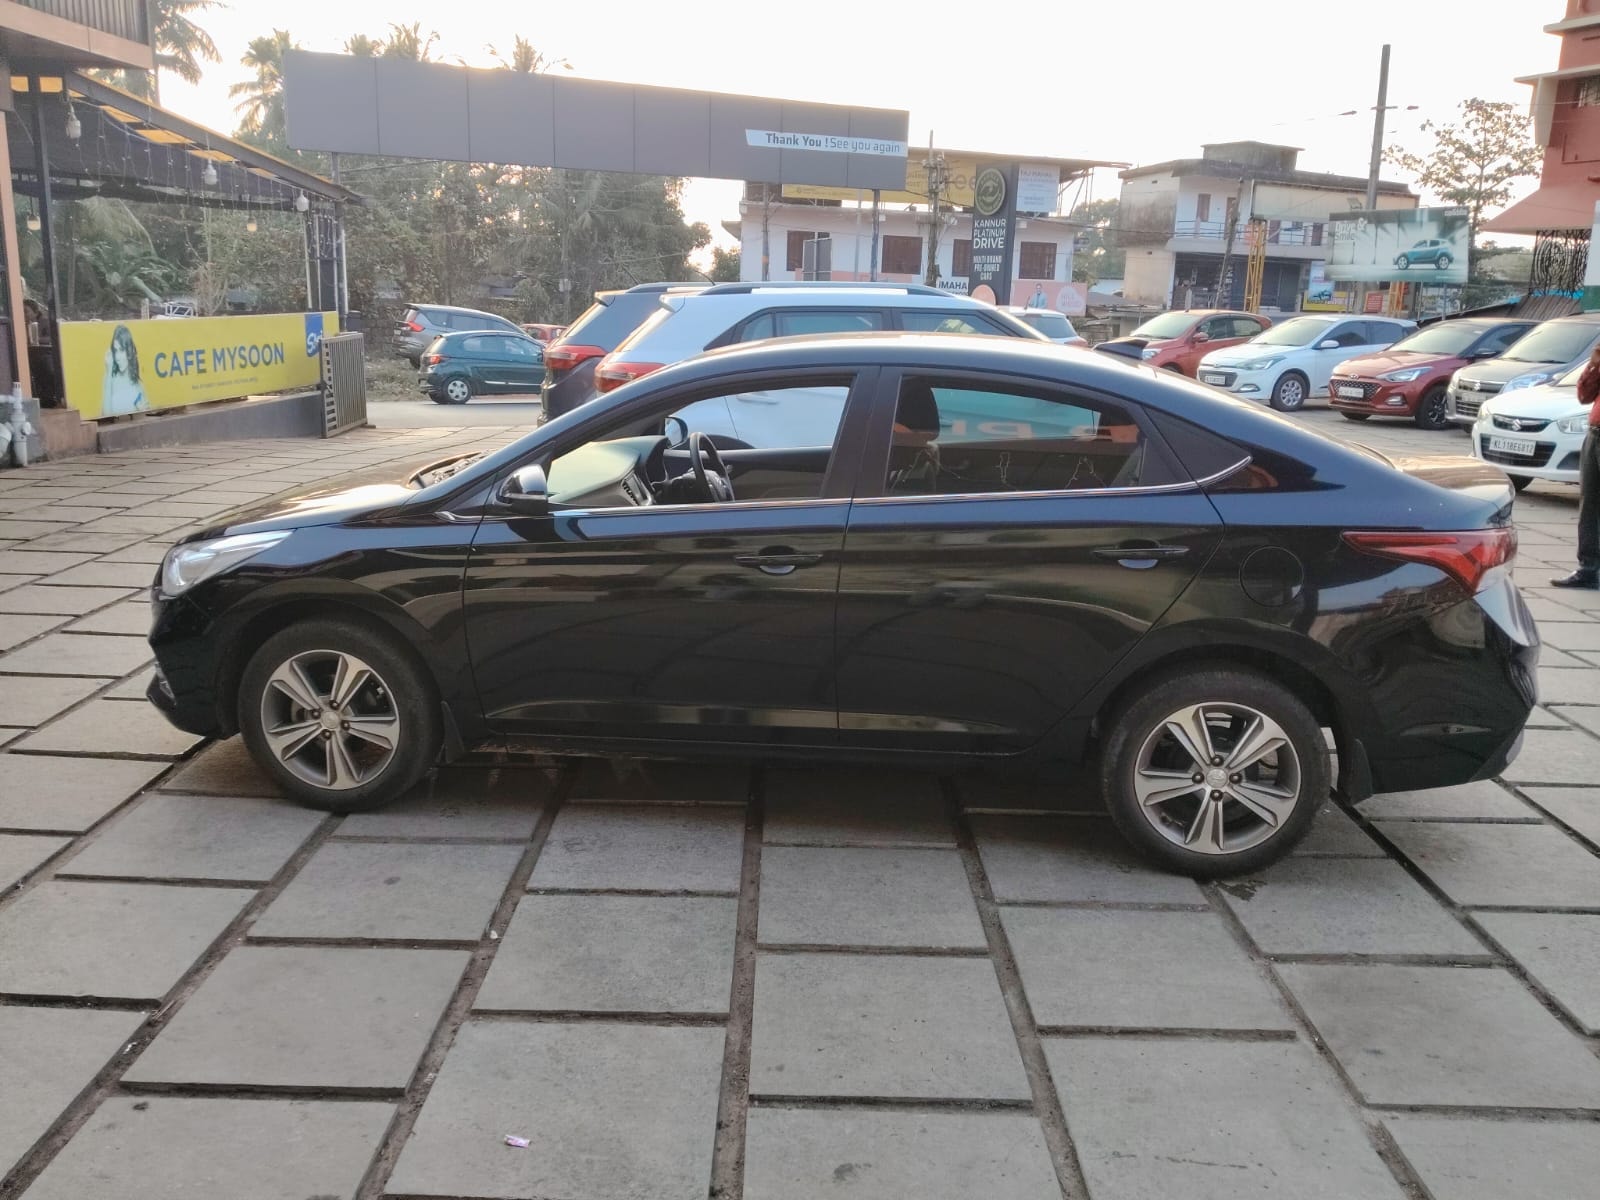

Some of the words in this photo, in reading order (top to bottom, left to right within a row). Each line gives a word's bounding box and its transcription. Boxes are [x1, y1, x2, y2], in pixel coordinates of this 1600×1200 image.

[766, 133, 800, 146] Thank
[803, 135, 822, 147] You
[830, 138, 849, 149] See
[852, 141, 871, 153] you
[873, 142, 900, 154] again
[974, 219, 1006, 228] KANNUR
[973, 228, 1006, 238] PLATINUM
[973, 238, 1005, 249] DRIVE
[154, 349, 207, 379] CAFE
[212, 341, 285, 373] MYSOON
